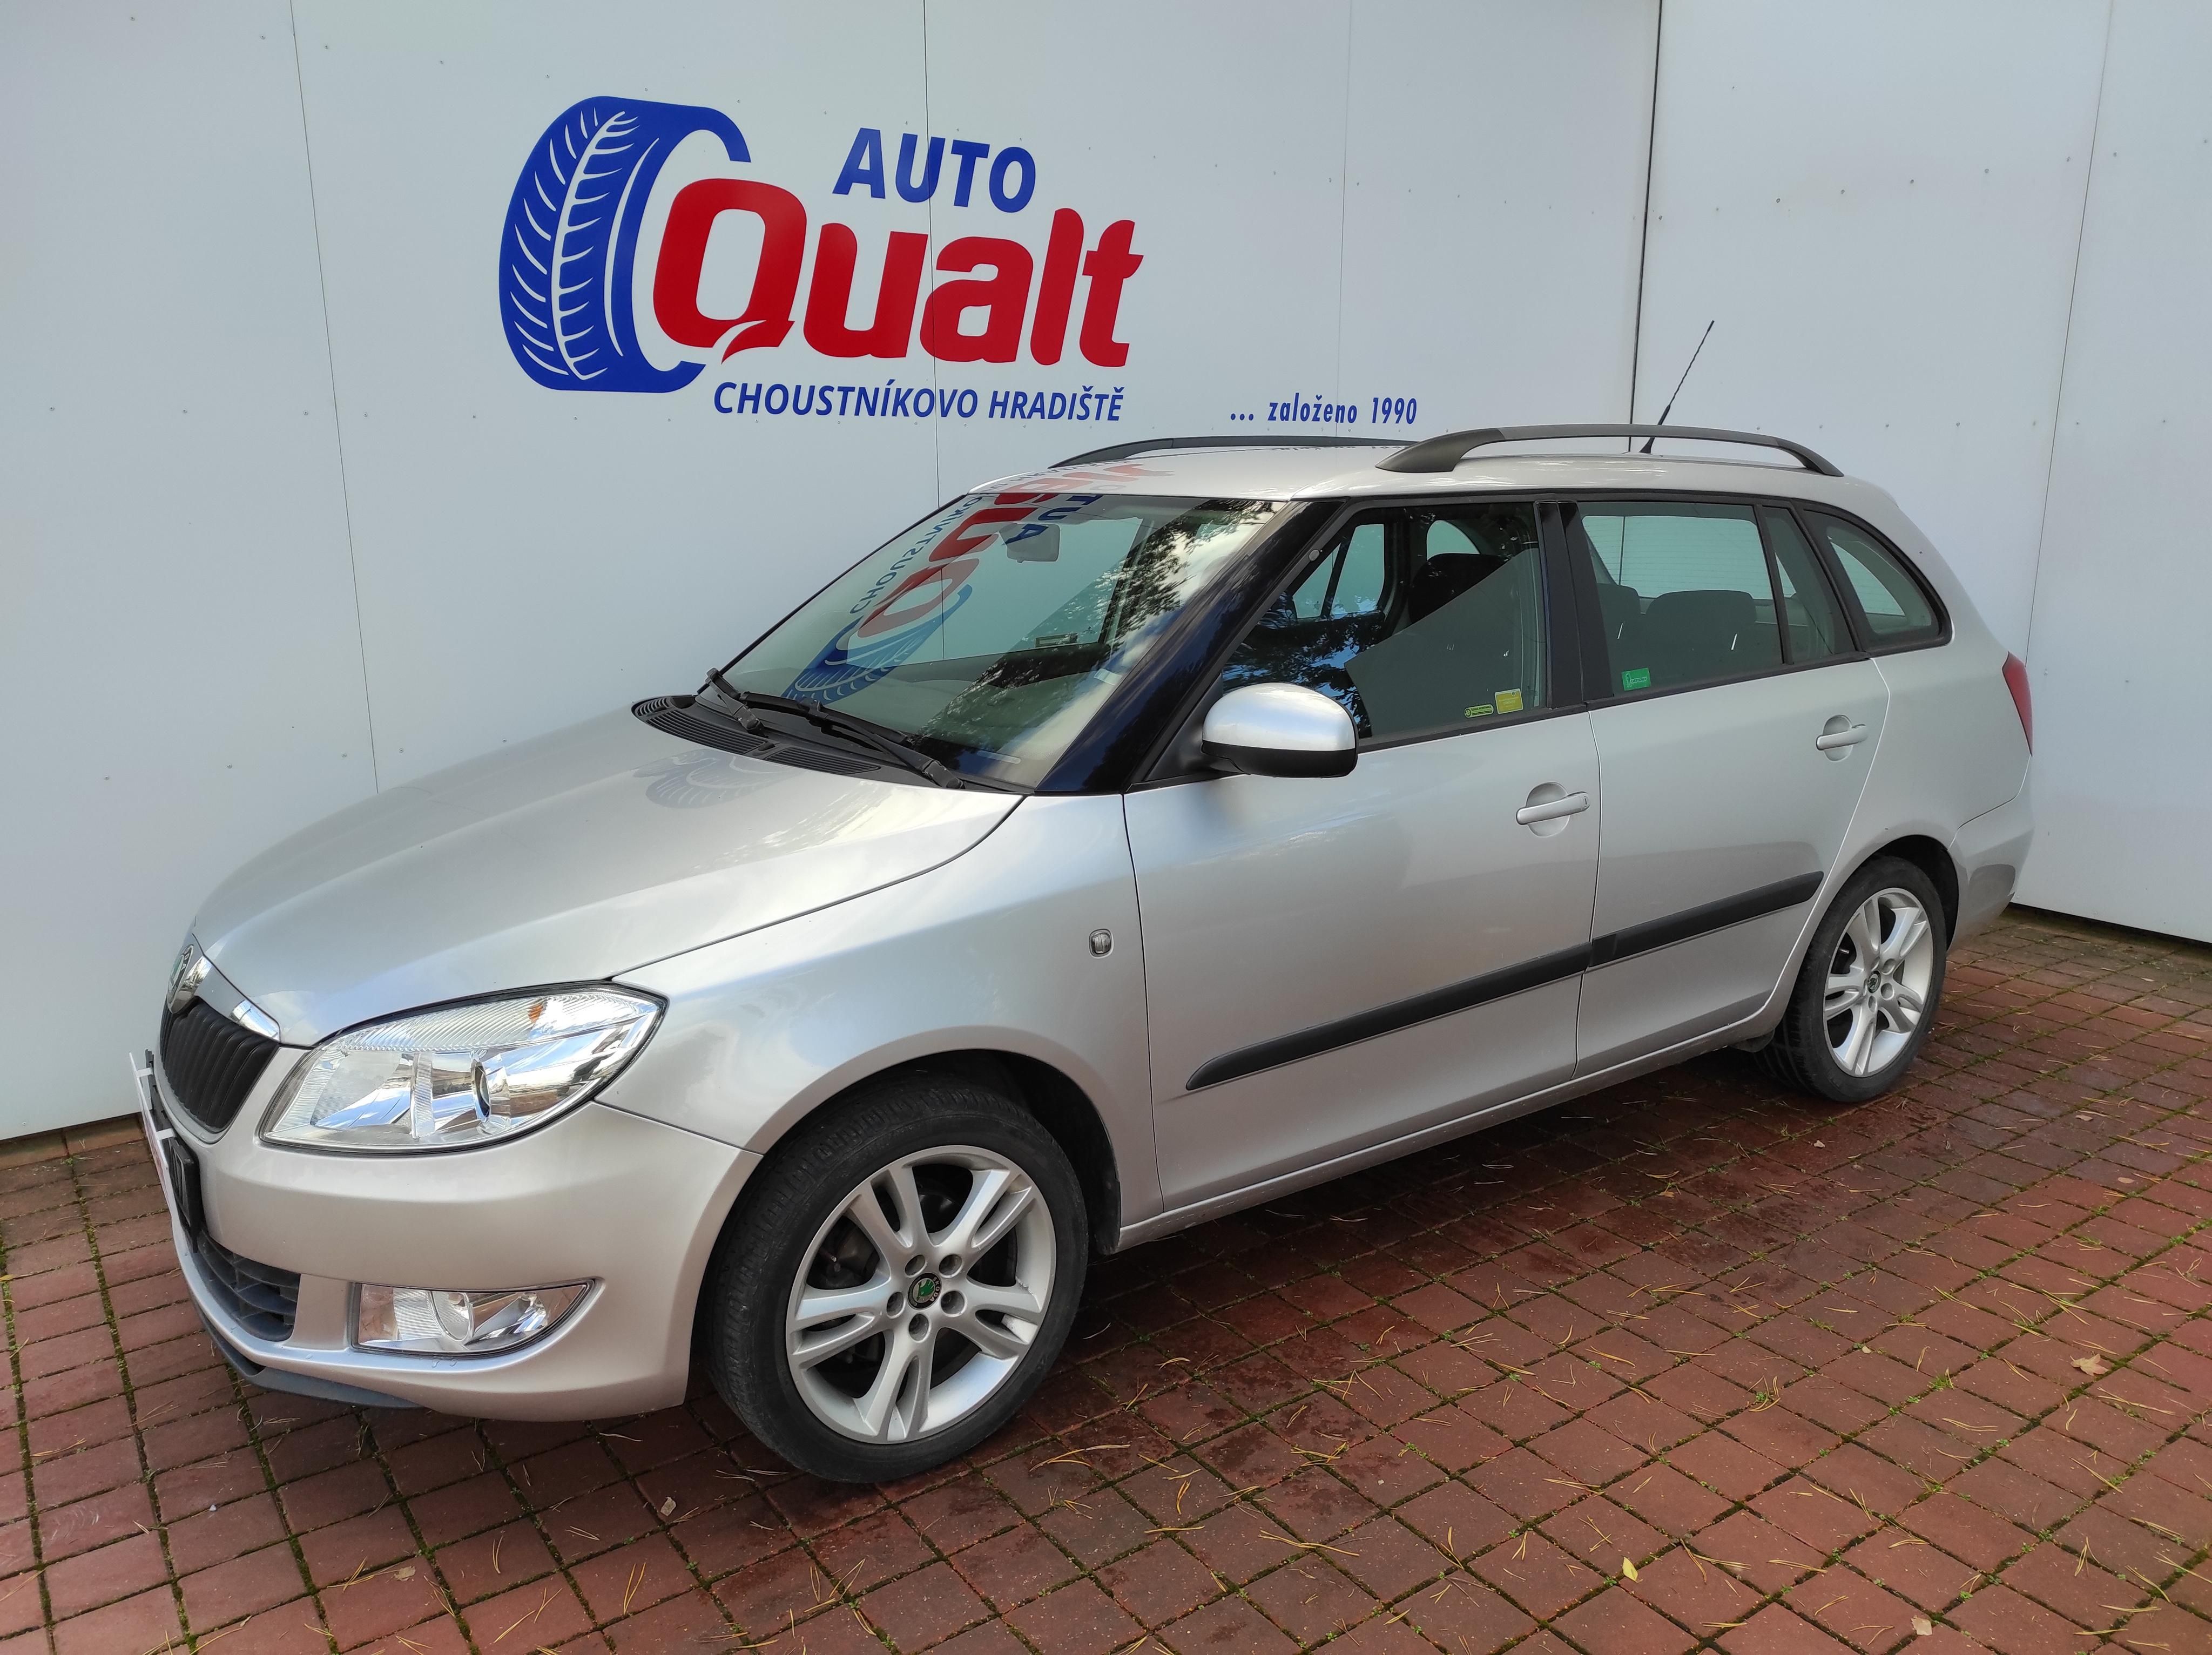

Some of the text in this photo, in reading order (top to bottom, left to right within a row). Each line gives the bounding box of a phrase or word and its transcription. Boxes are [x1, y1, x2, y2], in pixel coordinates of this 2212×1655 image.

[832, 127, 1036, 213] AUTO
[653, 178, 1143, 367] Qualt
[713, 378, 1124, 422] CHOUSTNÍKOVO HRADIŠTĚ
[1267, 392, 1357, 424] založeno
[1372, 397, 1418, 424] 1990
